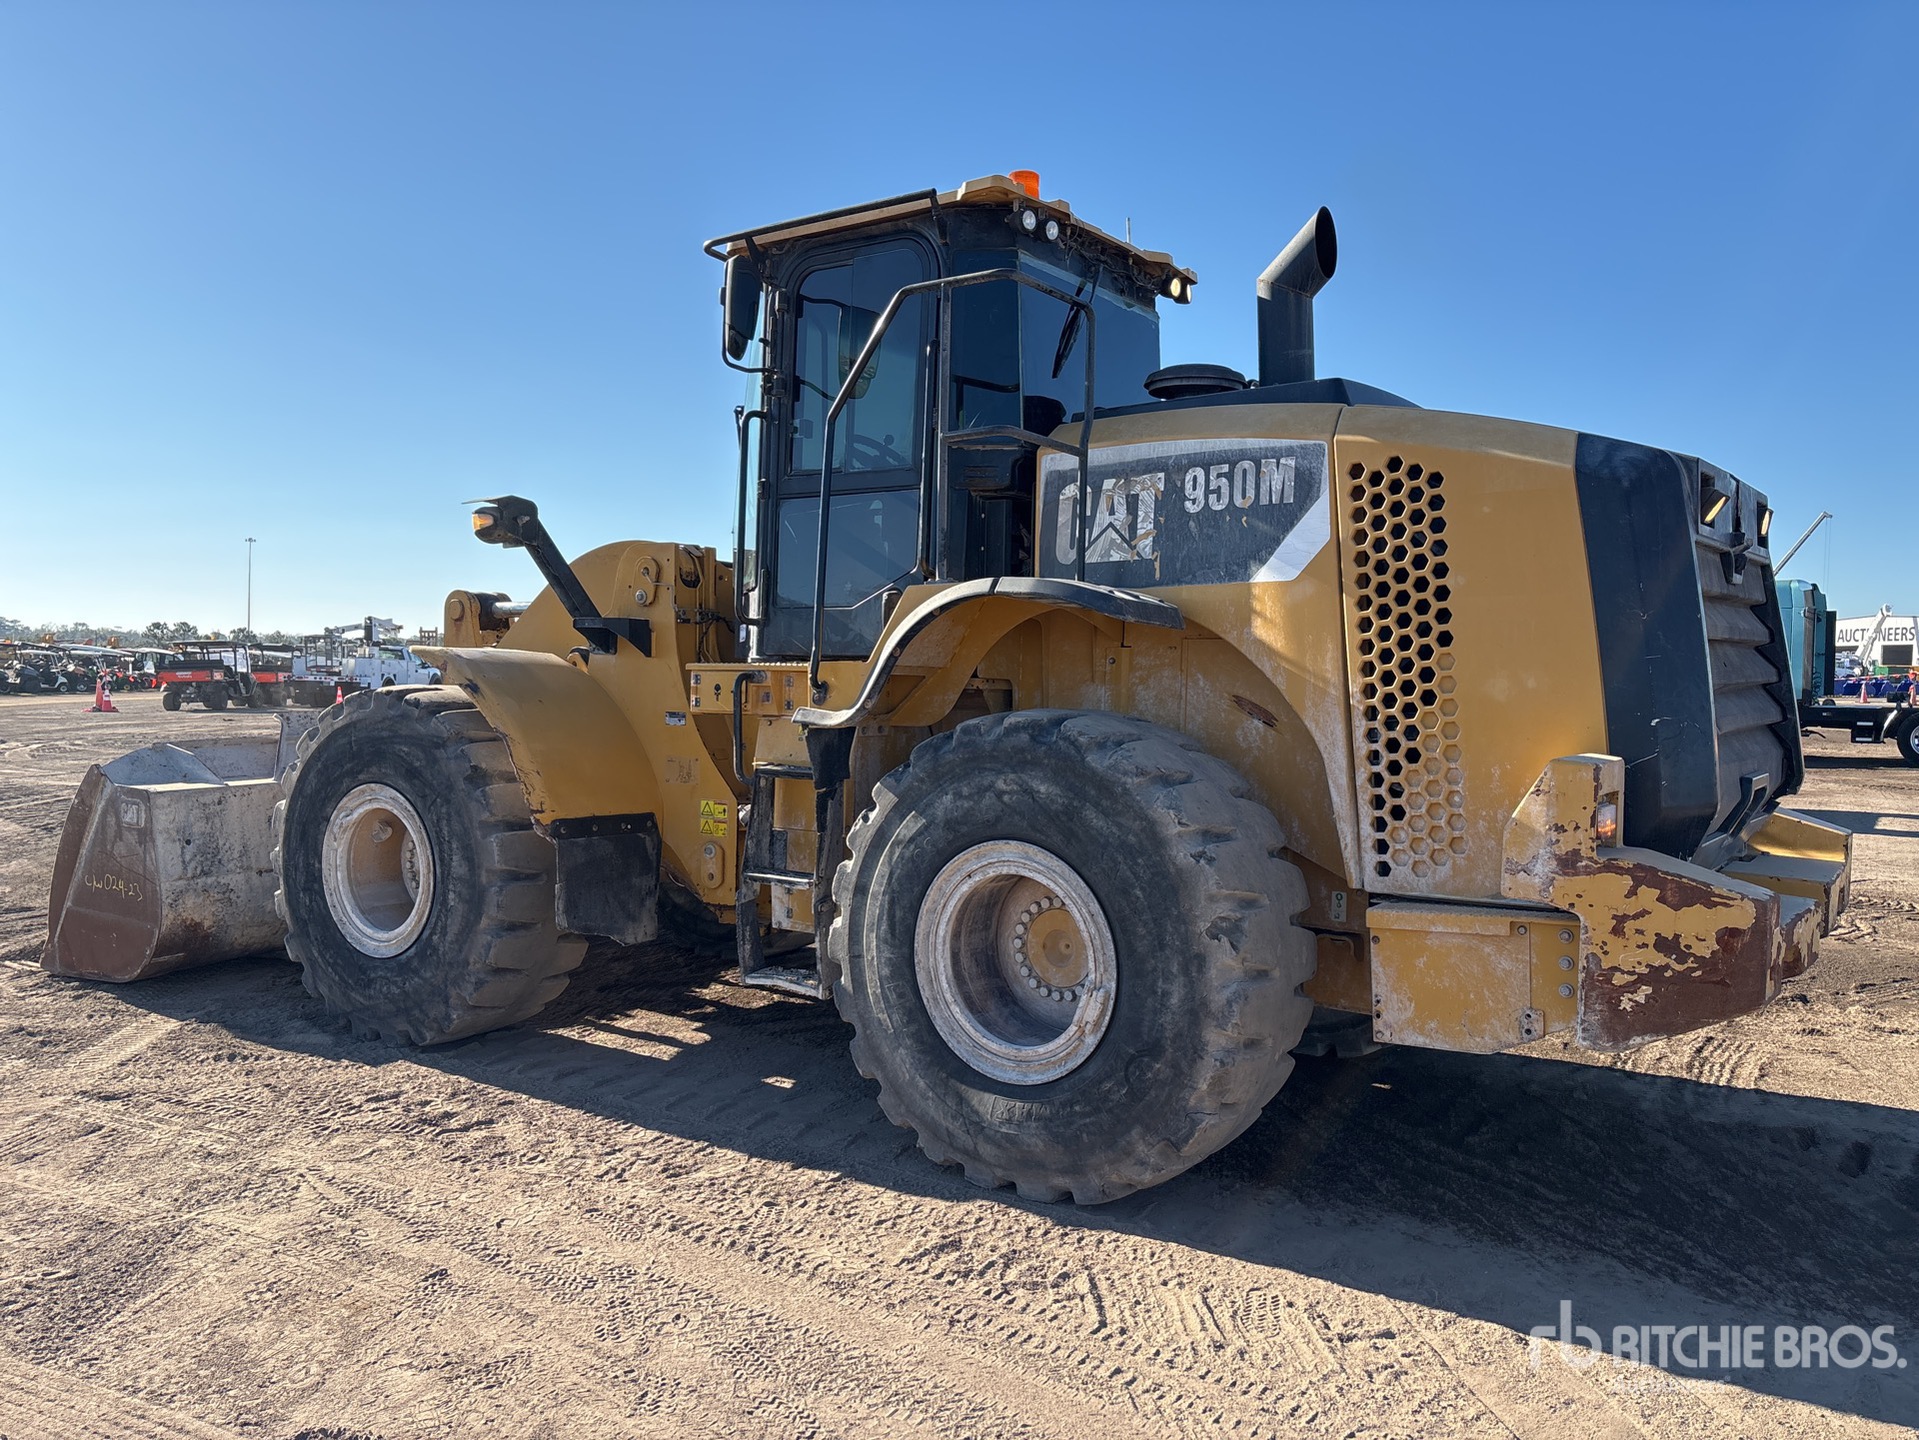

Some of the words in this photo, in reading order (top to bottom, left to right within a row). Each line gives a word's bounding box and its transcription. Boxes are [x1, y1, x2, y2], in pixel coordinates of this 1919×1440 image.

[1183, 456, 1296, 513] 950M
[1056, 473, 1165, 564] CAT
[1837, 626, 1915, 642] AUCTNEERS
